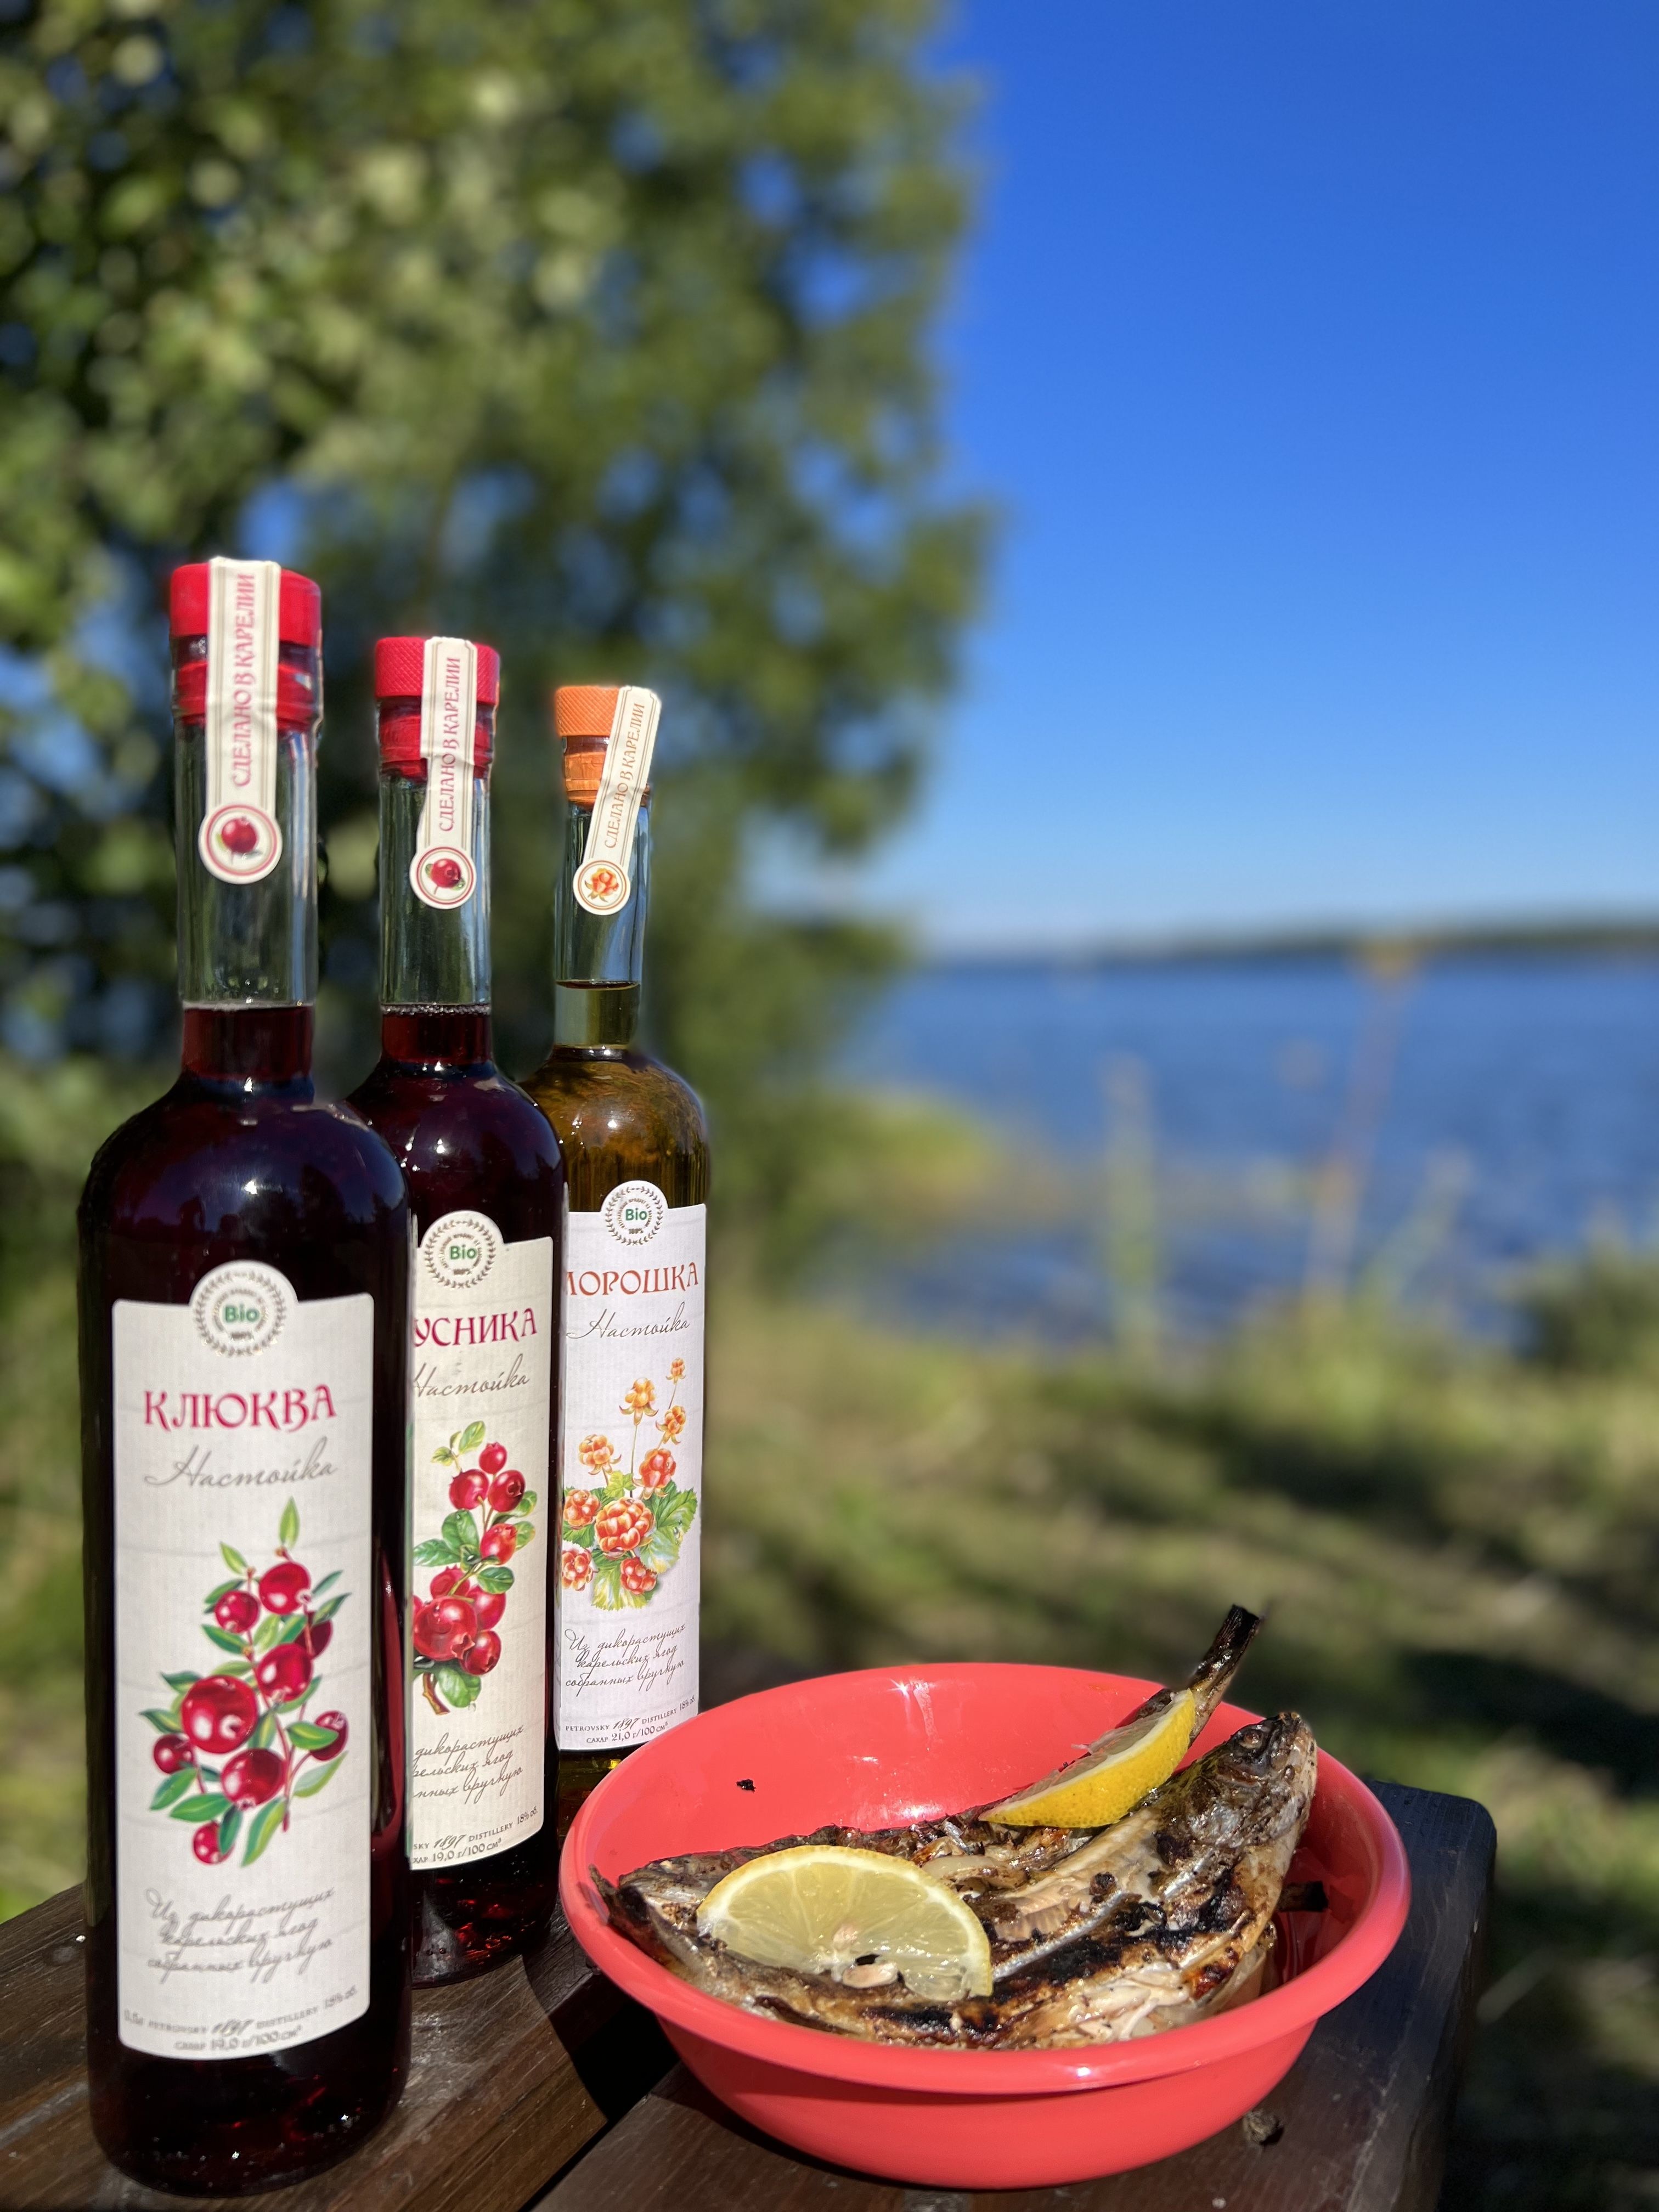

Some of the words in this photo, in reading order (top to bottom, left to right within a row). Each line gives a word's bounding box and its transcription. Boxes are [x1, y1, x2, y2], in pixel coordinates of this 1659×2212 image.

[233, 573, 255, 670] КАРЕЛИИ
[233, 673, 255, 687] В
[443, 657, 461, 736] КАРЕЛИИ
[232, 690, 254, 787] СДЕЛАНО
[442, 738, 459, 752] В
[621, 703, 646, 768] КАРЕЛИИ
[619, 765, 633, 781] В
[439, 753, 456, 832] СДЕЛАНО
[604, 782, 629, 849] СДЕЛАНО
[625, 1207, 648, 1221] Bio
[450, 1243, 477, 1260] Bio
[224, 1303, 259, 1323] Bio
[414, 1307, 538, 1347] УСНИКА
[566, 1301, 690, 1339] Настойка
[144, 1384, 337, 1433] КЛЮКВА
[144, 1436, 338, 1489] Настойка
[565, 1628, 590, 1657] Из
[592, 1624, 686, 1662] дикорастущих
[575, 1645, 651, 1674] карельских
[652, 1645, 678, 1673] ягод
[566, 1672, 634, 1697] собранных
[636, 1660, 685, 1692] вручную
[611, 1730, 630, 1742] 21,0
[612, 1717, 641, 1731] 1897
[642, 1708, 677, 1725] DISTILLERY
[482, 1750, 514, 1779] ягод
[413, 1786, 459, 1798] нных
[463, 1767, 523, 1804] вручную
[433, 1834, 467, 1850] 1897
[469, 1822, 514, 1842] DISTILLERY
[413, 1856, 428, 1864] ХАР
[433, 1850, 455, 1863] 19,0
[257, 2006, 318, 2029] DISTILLERY
